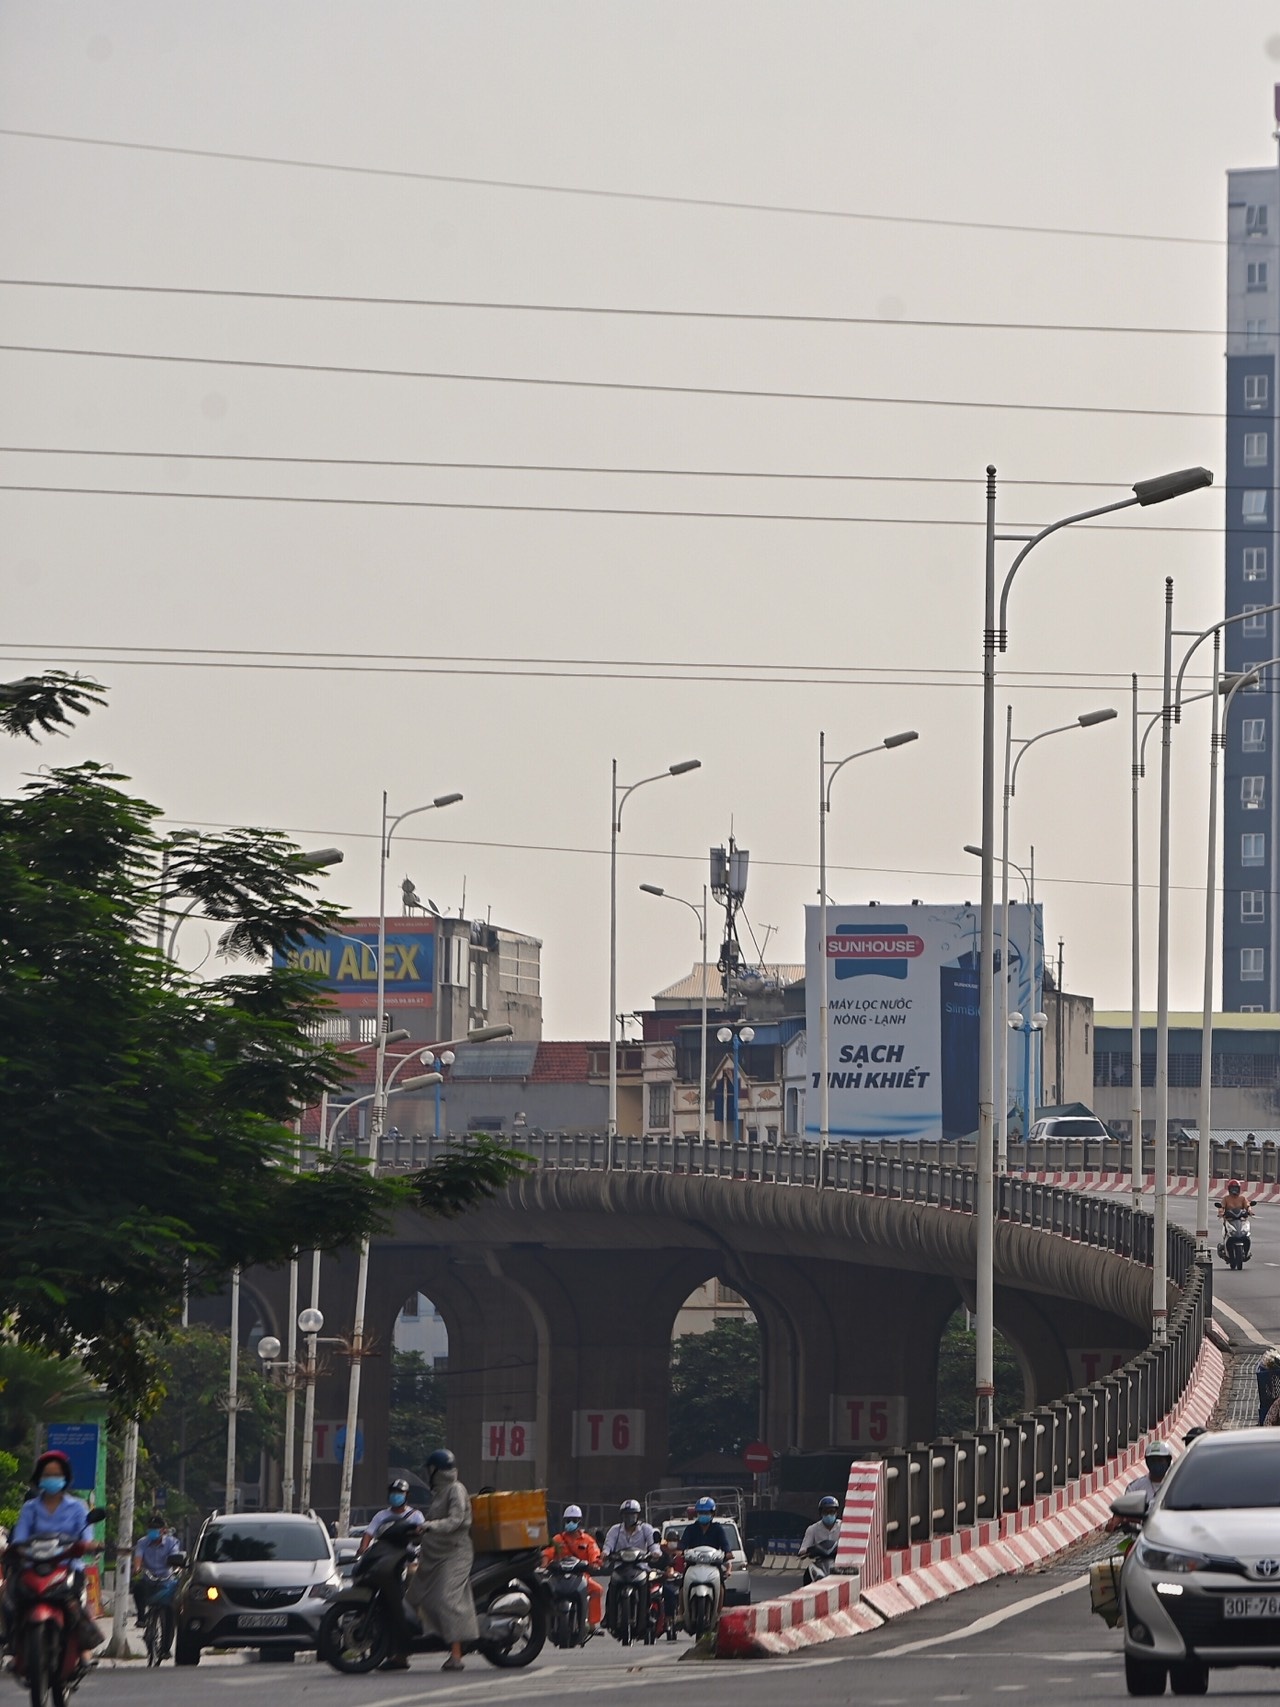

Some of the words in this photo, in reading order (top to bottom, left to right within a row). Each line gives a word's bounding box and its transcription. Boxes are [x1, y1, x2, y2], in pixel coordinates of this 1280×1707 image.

[828, 940, 915, 953] SUNHOUSE
[336, 944, 420, 980] ALEX
[828, 998, 854, 1010] MÁY
[855, 999, 880, 1012] LỌC
[874, 1014, 907, 1027] LẠNH
[838, 1044, 905, 1069] SẠCH
[864, 1066, 930, 1089] KHIẾT
[846, 1400, 889, 1442] T5
[489, 1425, 526, 1457] H8
